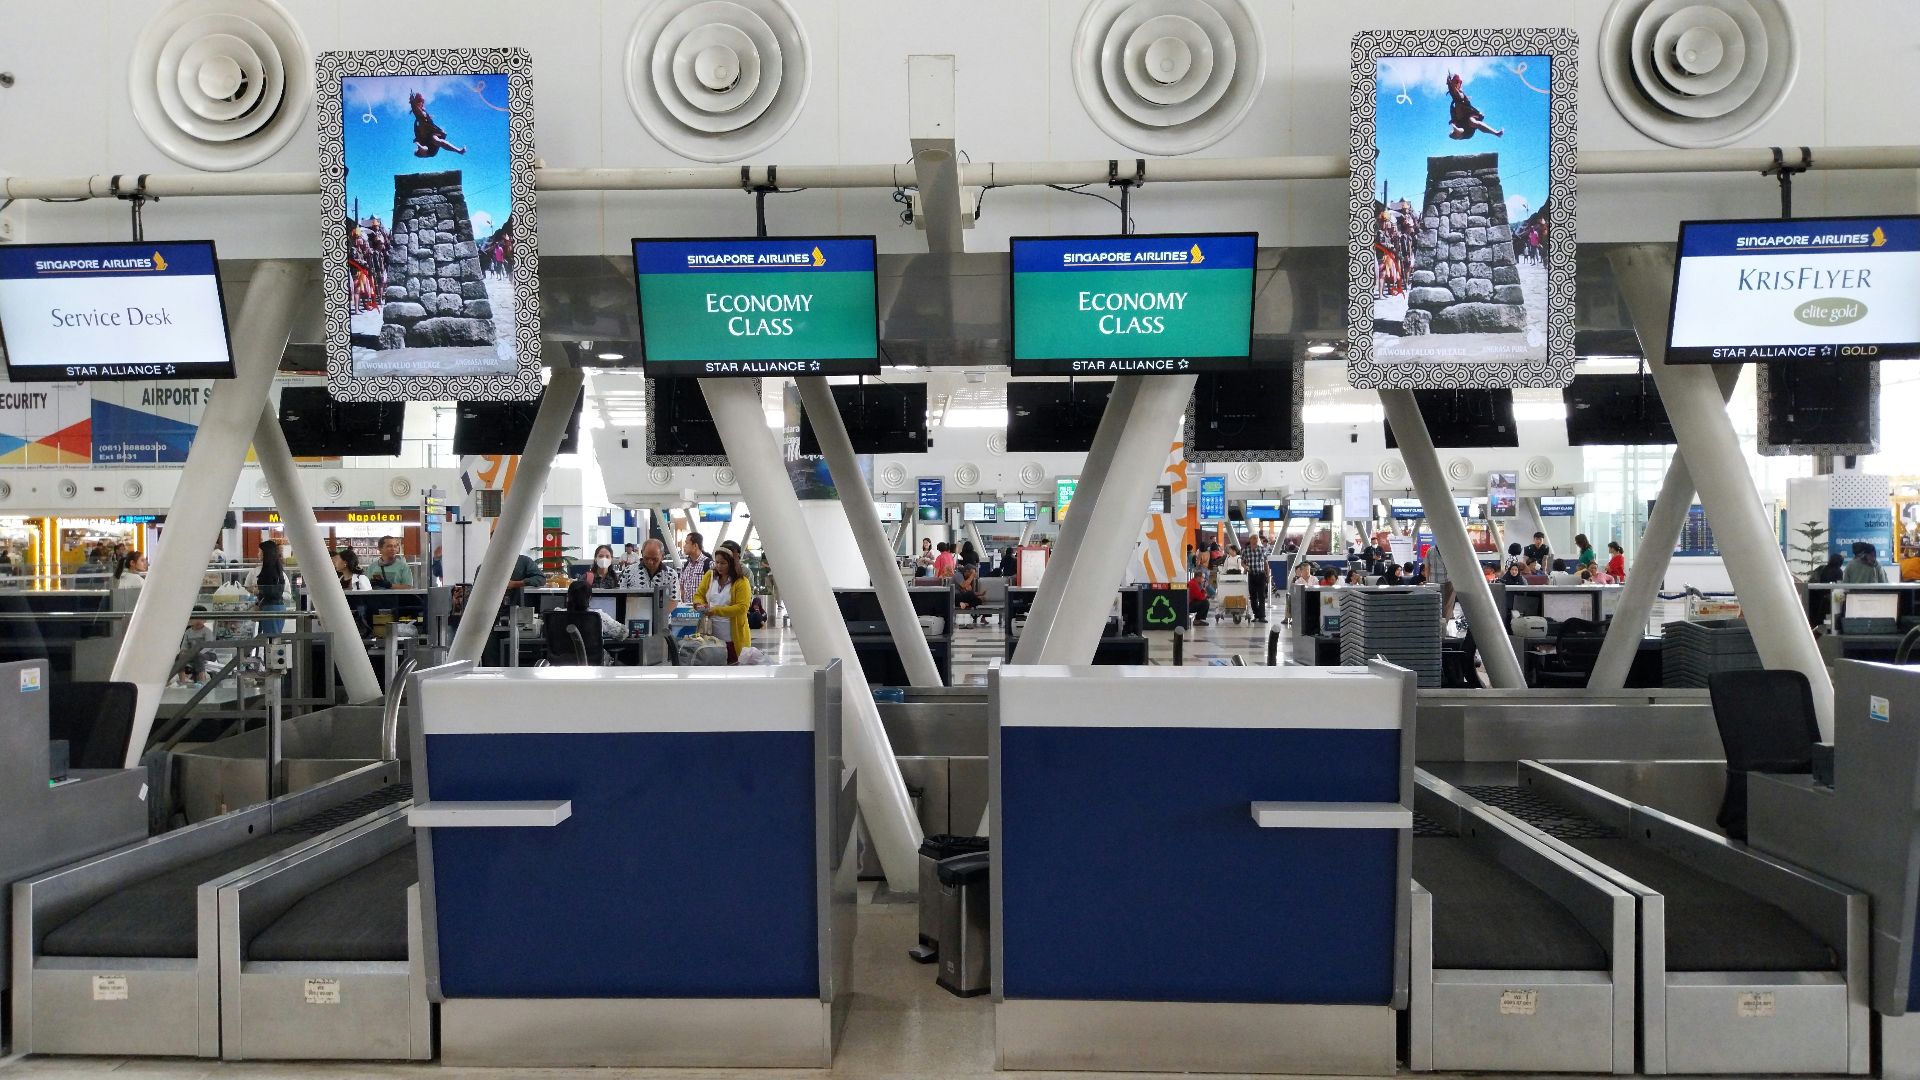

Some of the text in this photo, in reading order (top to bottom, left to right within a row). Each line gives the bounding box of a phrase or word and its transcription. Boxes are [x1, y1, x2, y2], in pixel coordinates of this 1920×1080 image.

[1736, 233, 1869, 247] SINGAPORE AIRLINES
[687, 253, 810, 264] SINGAPORE AIRLINES
[1063, 251, 1188, 263] SINGAPORE AIRLINES
[35, 258, 151, 270] SINGAPORE AIRLINES
[706, 293, 813, 313] ECONOMY
[1079, 291, 1188, 311] ECONOMY
[51, 307, 173, 328] Service Desk
[1802, 303, 1858, 322] elite gold
[728, 316, 793, 336] CLASS
[1099, 314, 1165, 335] CLASS
[1712, 345, 1878, 358] STAR ALLIANCE GOLD
[66, 365, 162, 376] STAR ALLIANCE
[706, 361, 806, 372] STAR ALLIANCE
[1072, 359, 1174, 370] STAR ALLIANCE
[141, 388, 199, 406] AIRPORT
[348, 513, 402, 523] Napoleon
[1864, 520, 1889, 528] station
